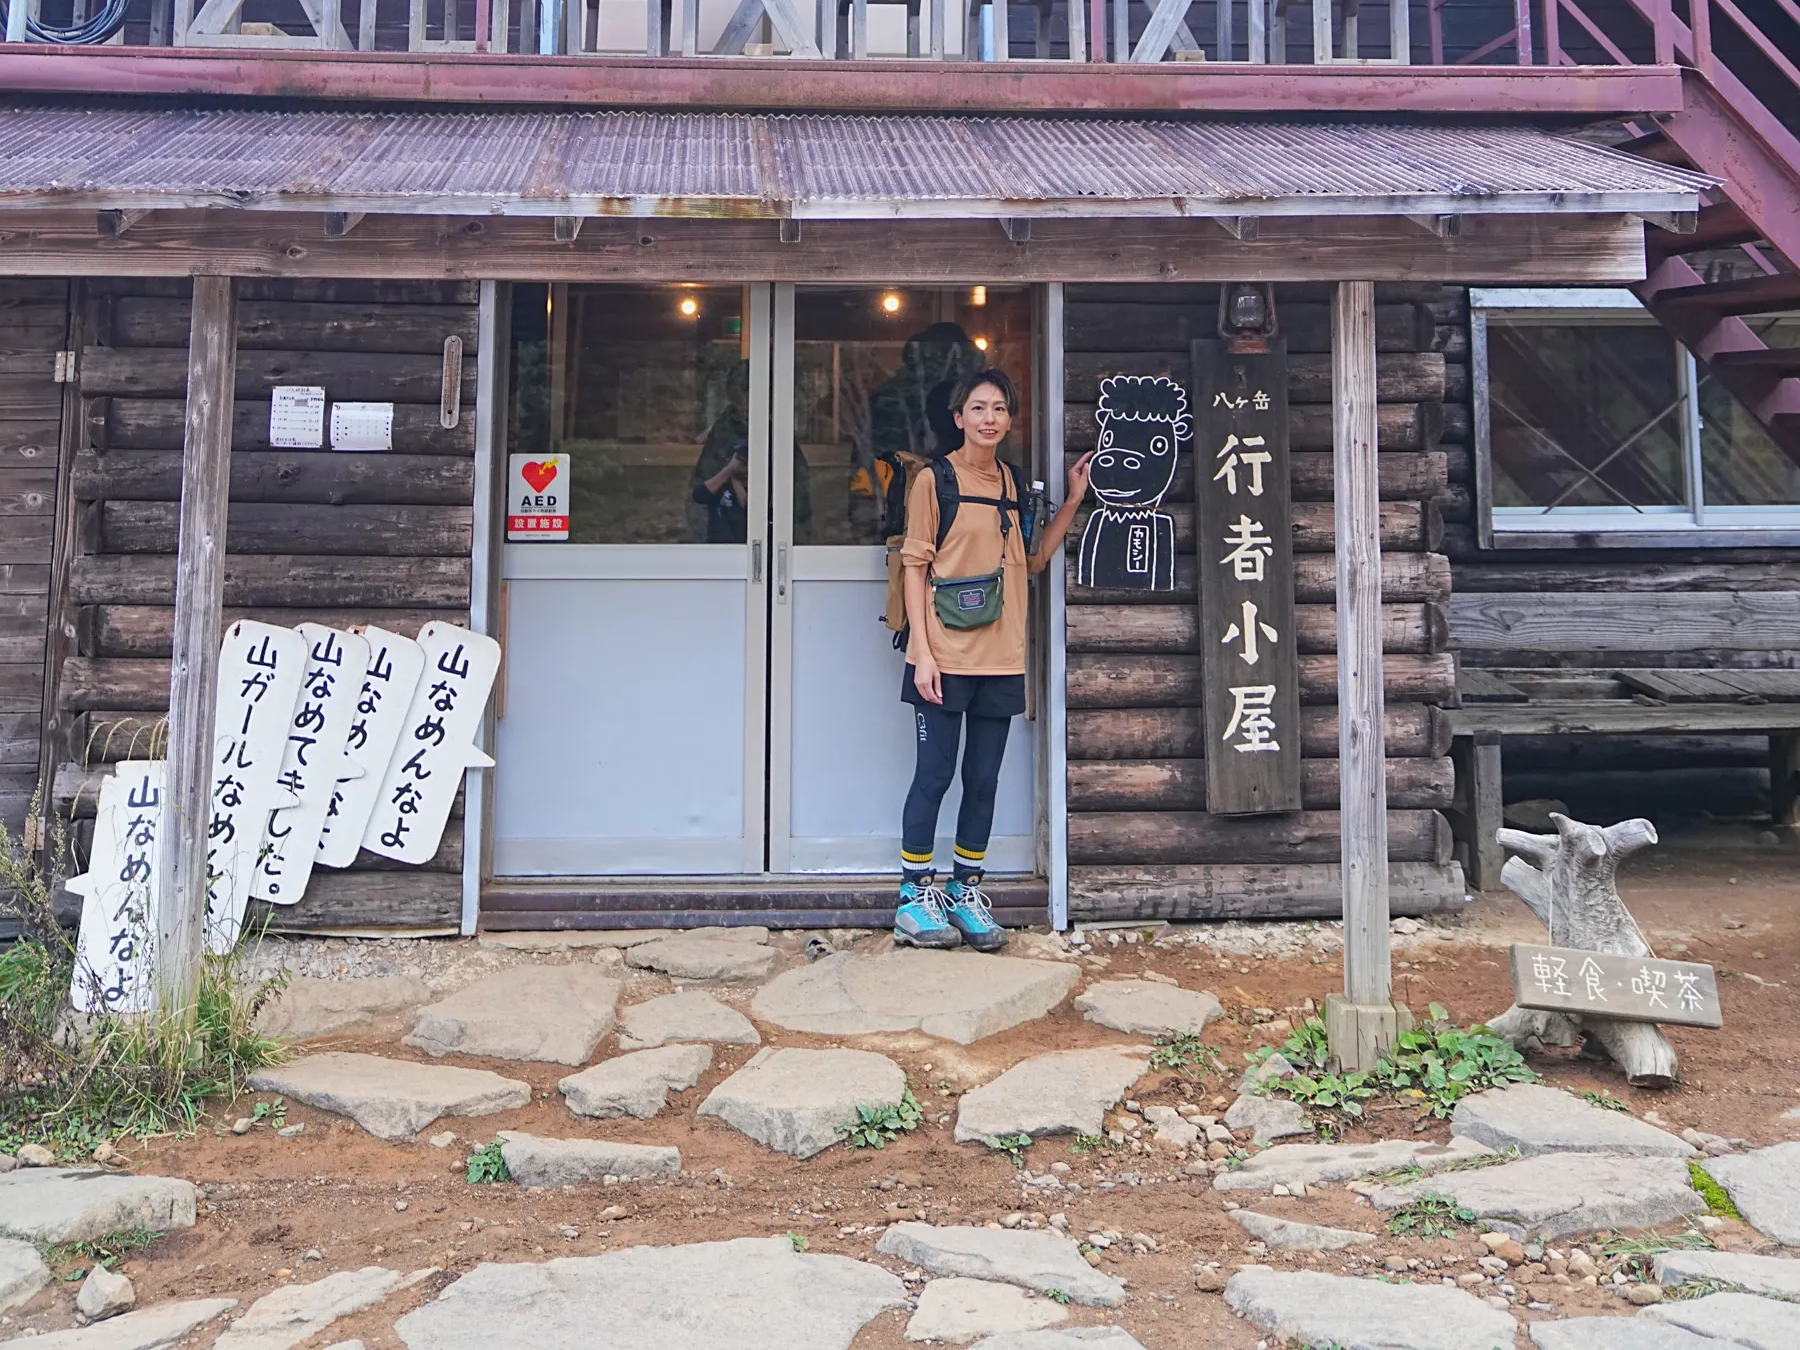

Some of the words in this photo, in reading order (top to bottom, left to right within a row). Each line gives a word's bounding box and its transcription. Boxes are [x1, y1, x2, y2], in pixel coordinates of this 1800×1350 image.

[521, 495, 557, 507] AED
[1132, 528, 1144, 570] カモシー
[1213, 434, 1281, 753] 行者小屋
[203, 635, 277, 933] 山ガールなめん
[318, 647, 392, 850] 山なめ
[380, 643, 470, 849] 山なめんなよ
[1531, 952, 1705, 1013] 軽食・喫茶
